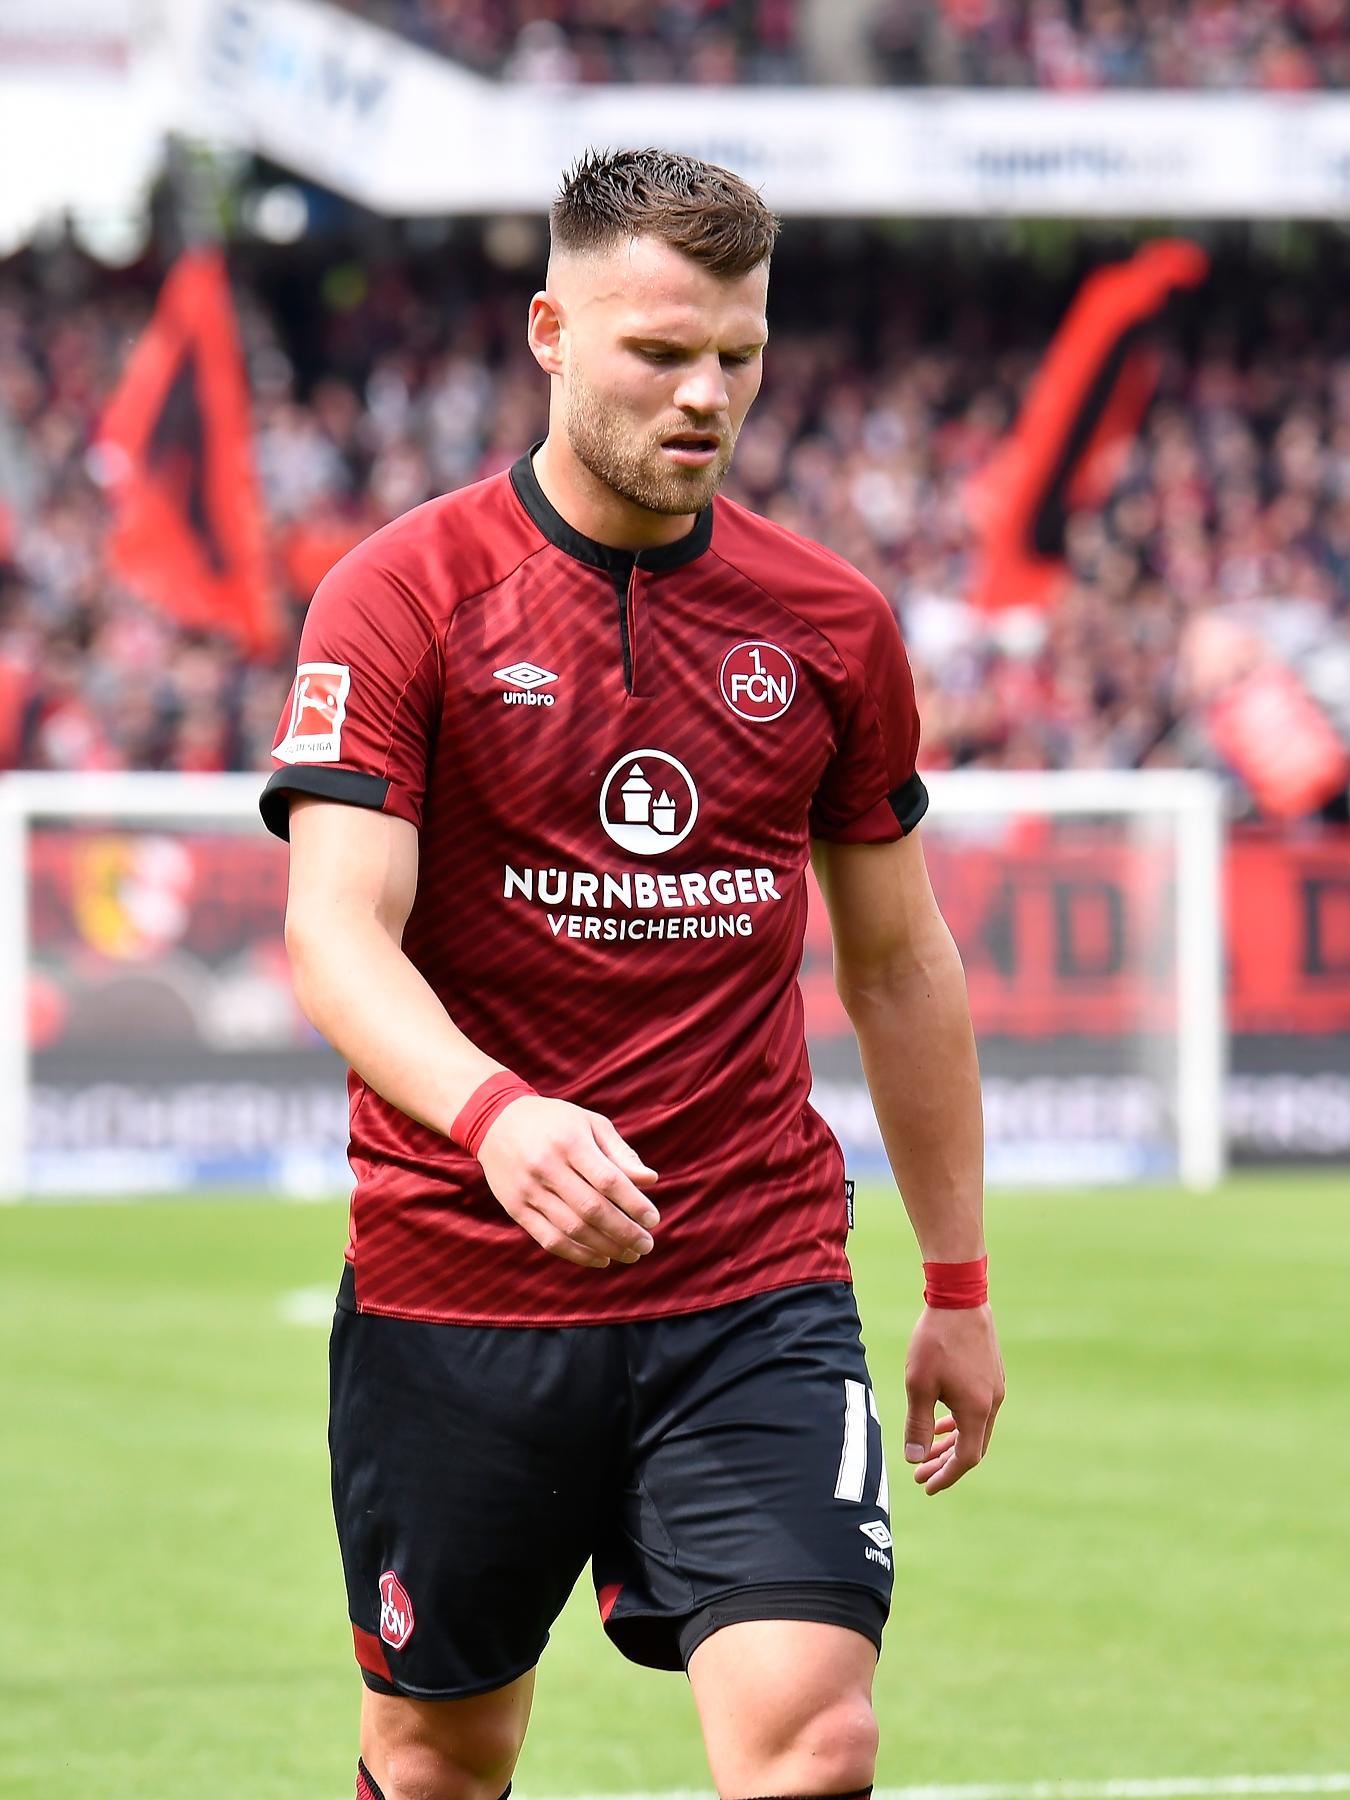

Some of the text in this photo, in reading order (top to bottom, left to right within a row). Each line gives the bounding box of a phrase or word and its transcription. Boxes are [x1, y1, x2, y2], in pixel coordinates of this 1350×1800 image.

[748, 647, 767, 675] 1.
[502, 690, 555, 707] umbro
[731, 673, 787, 705] FCN
[503, 864, 782, 909] NÜRNBERGER
[546, 913, 754, 941] VERSICHERUNG
